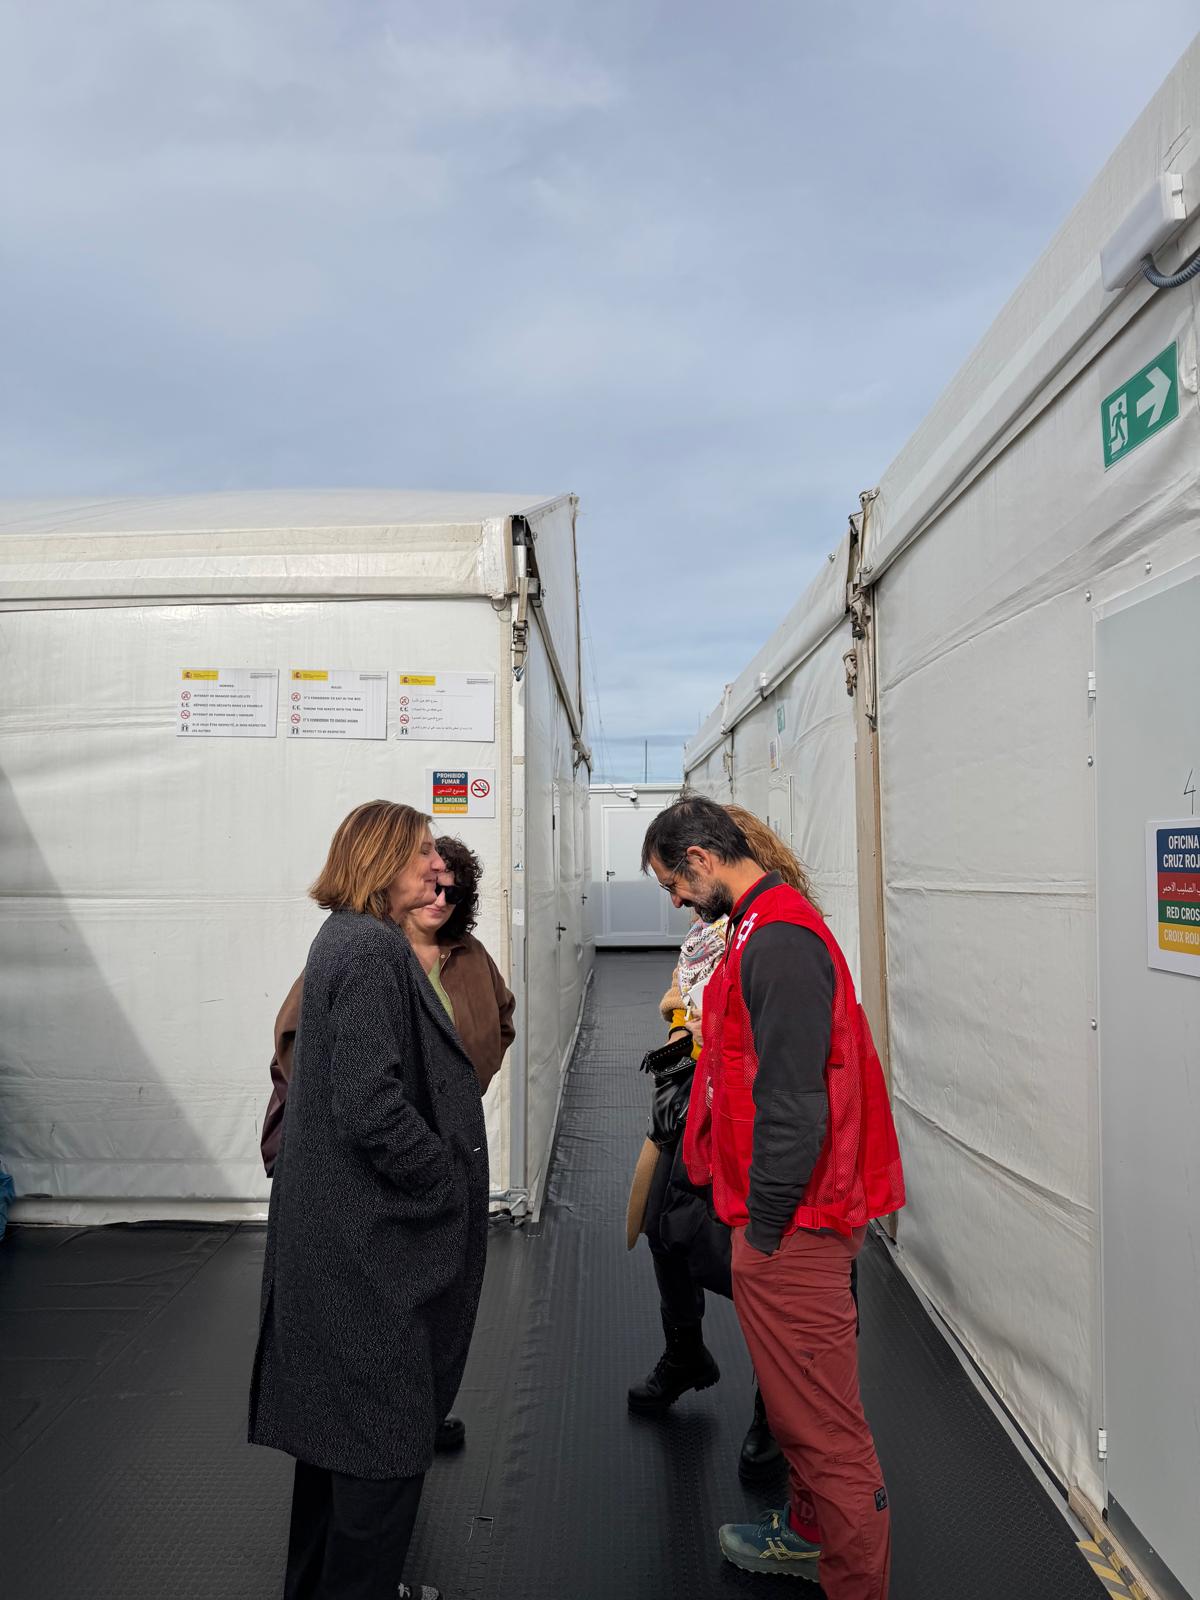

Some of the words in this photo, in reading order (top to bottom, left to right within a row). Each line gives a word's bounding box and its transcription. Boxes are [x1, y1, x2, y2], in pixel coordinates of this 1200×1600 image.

[1184, 768, 1197, 815] 4
[1168, 834, 1200, 850] OFICINA
[1163, 853, 1184, 868] CRUZ
[1166, 906, 1180, 919] RED
[1163, 928, 1184, 943] CROIX
